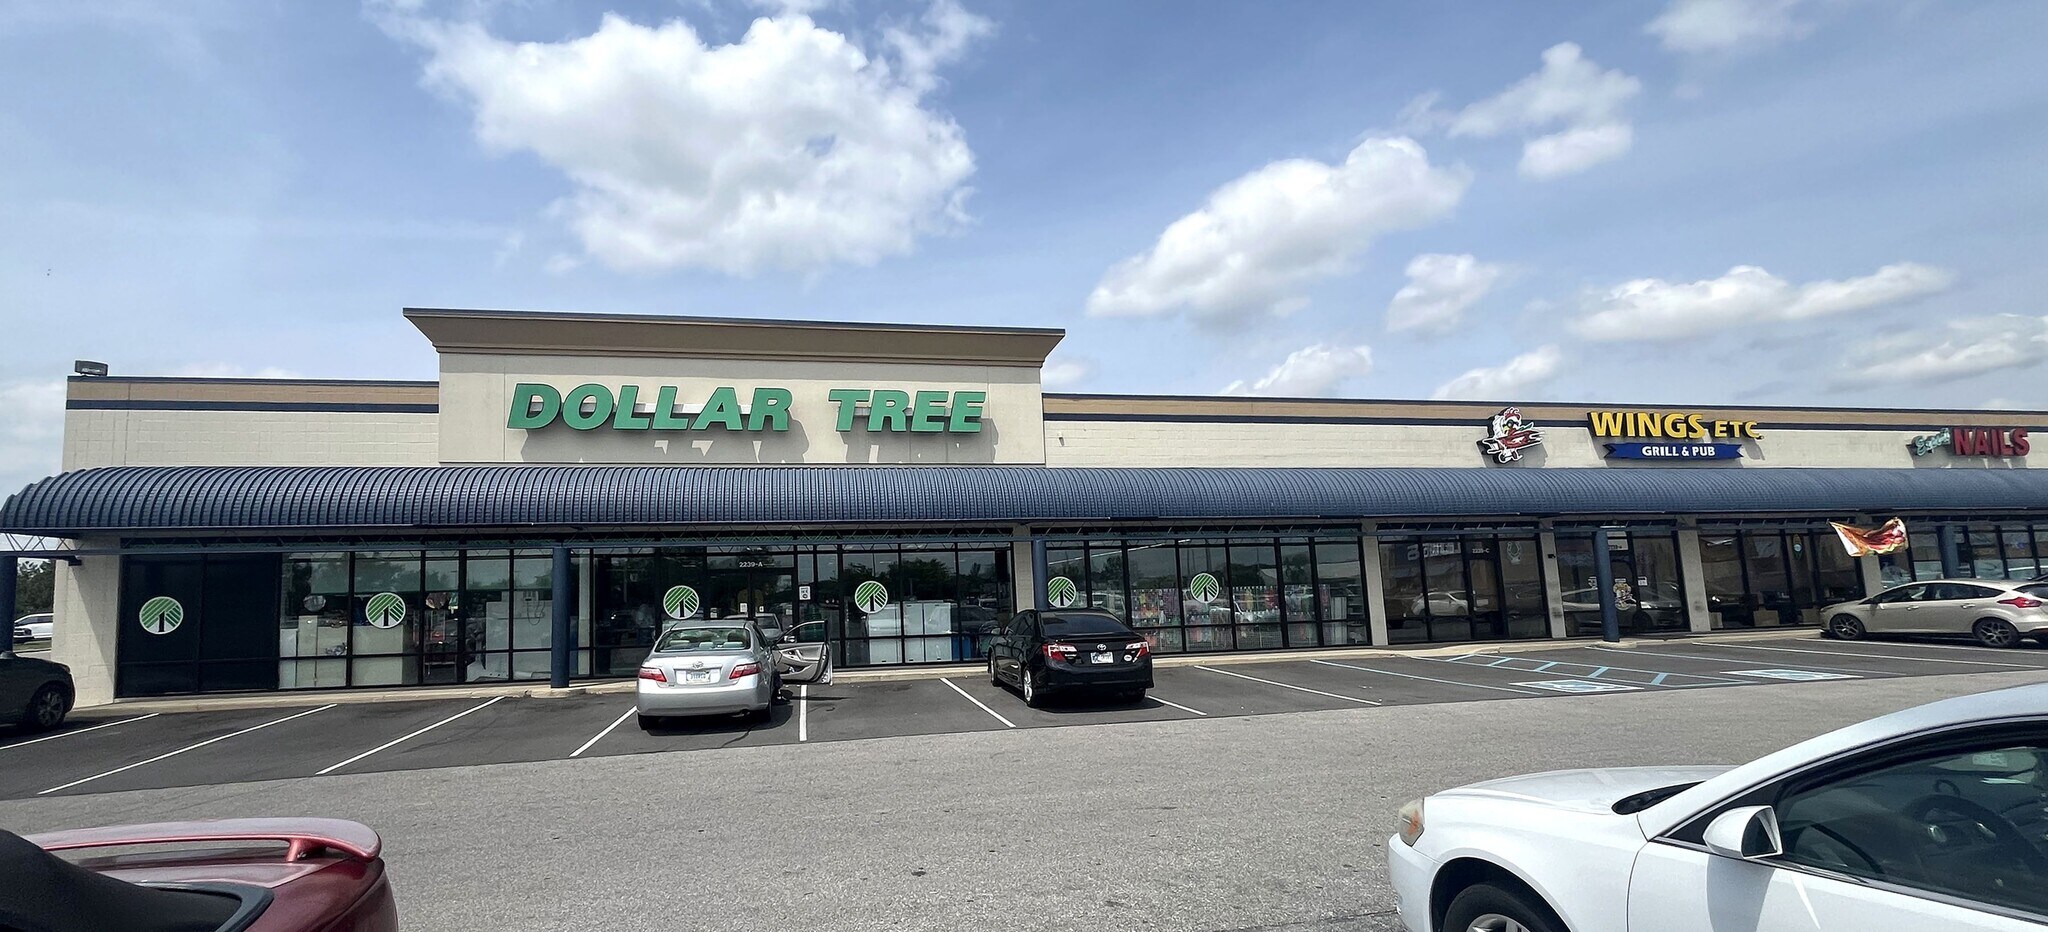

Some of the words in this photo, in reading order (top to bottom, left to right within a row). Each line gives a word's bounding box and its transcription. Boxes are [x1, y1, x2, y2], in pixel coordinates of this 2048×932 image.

[506, 383, 794, 432] DOLLAR
[828, 388, 986, 433] TREE
[1589, 411, 1706, 439] WINGS
[1641, 446, 1679, 457] GRILL
[1681, 447, 1689, 457] &
[1692, 446, 1716, 457] PUB
[1953, 426, 2030, 457] NAILS
